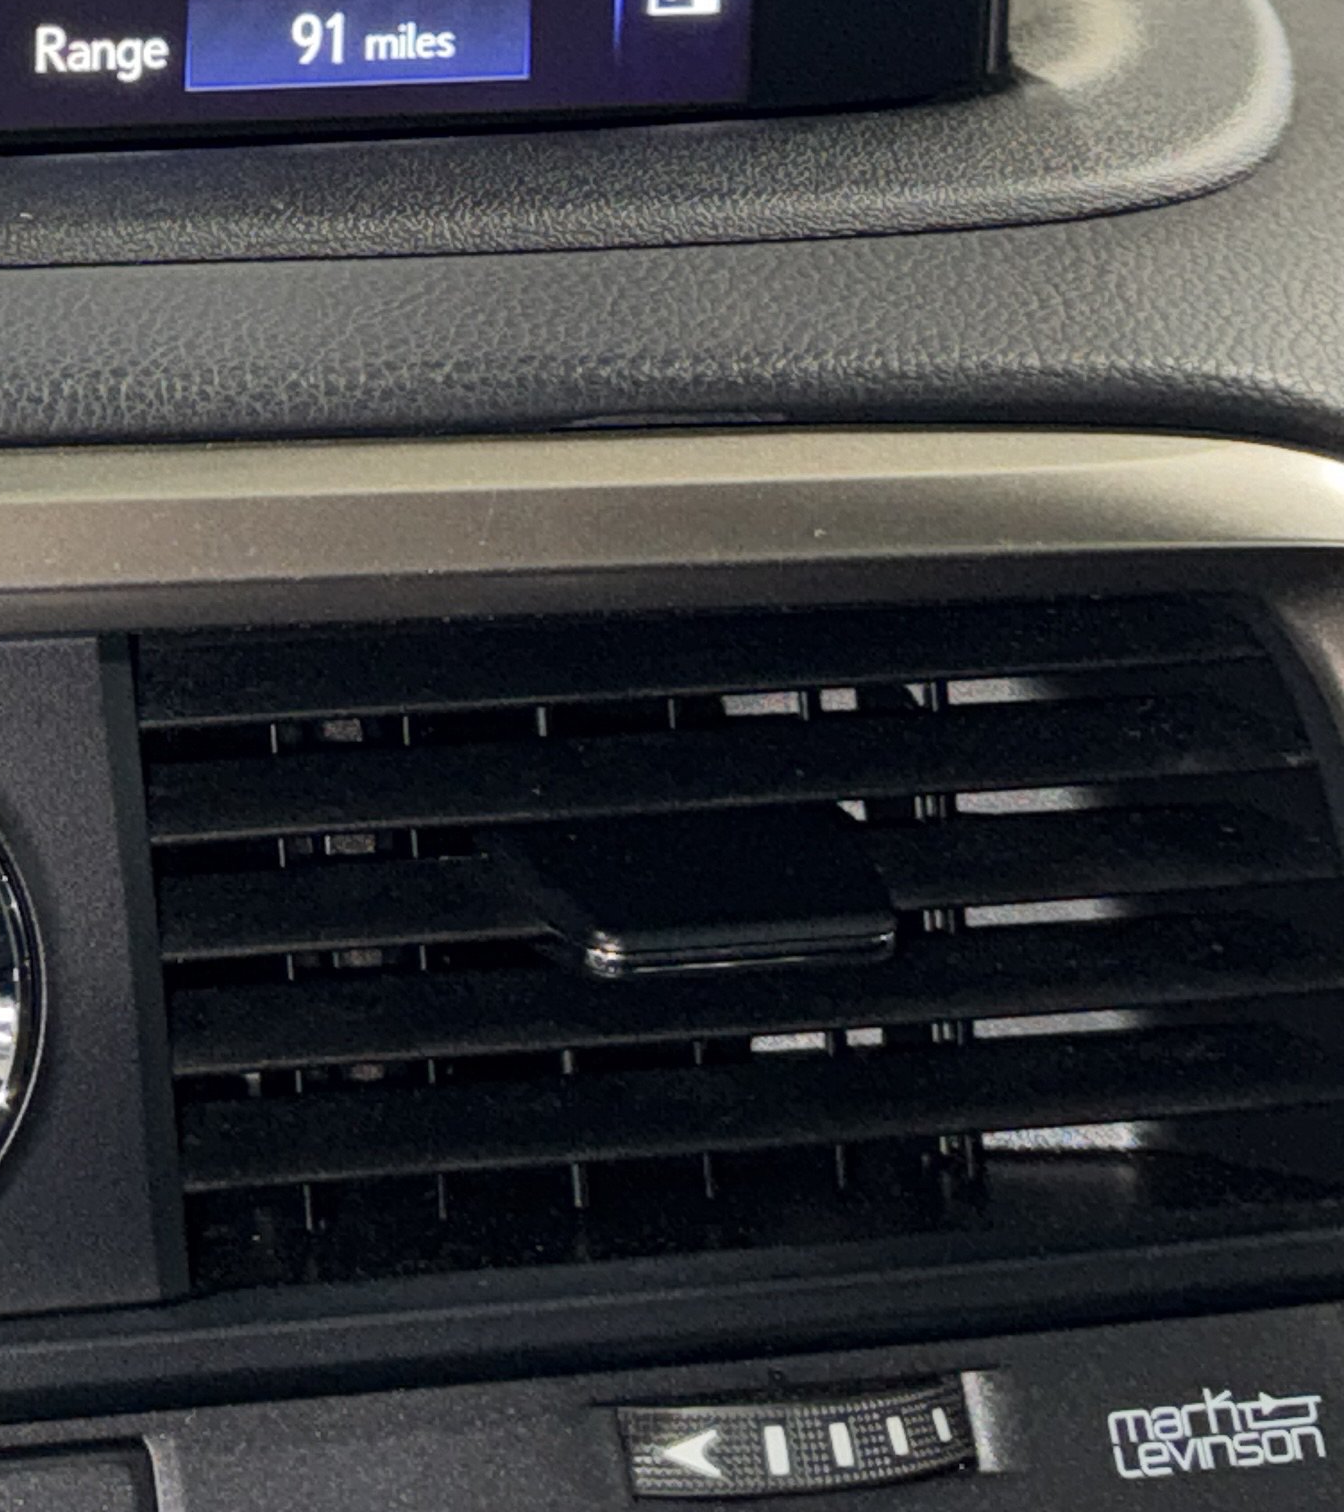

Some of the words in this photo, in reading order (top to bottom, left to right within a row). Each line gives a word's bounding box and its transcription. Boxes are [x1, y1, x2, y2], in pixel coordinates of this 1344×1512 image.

[34, 24, 171, 83] Range
[290, 11, 345, 66] 91
[364, 21, 456, 62] miles
[1108, 1387, 1243, 1443] mark
